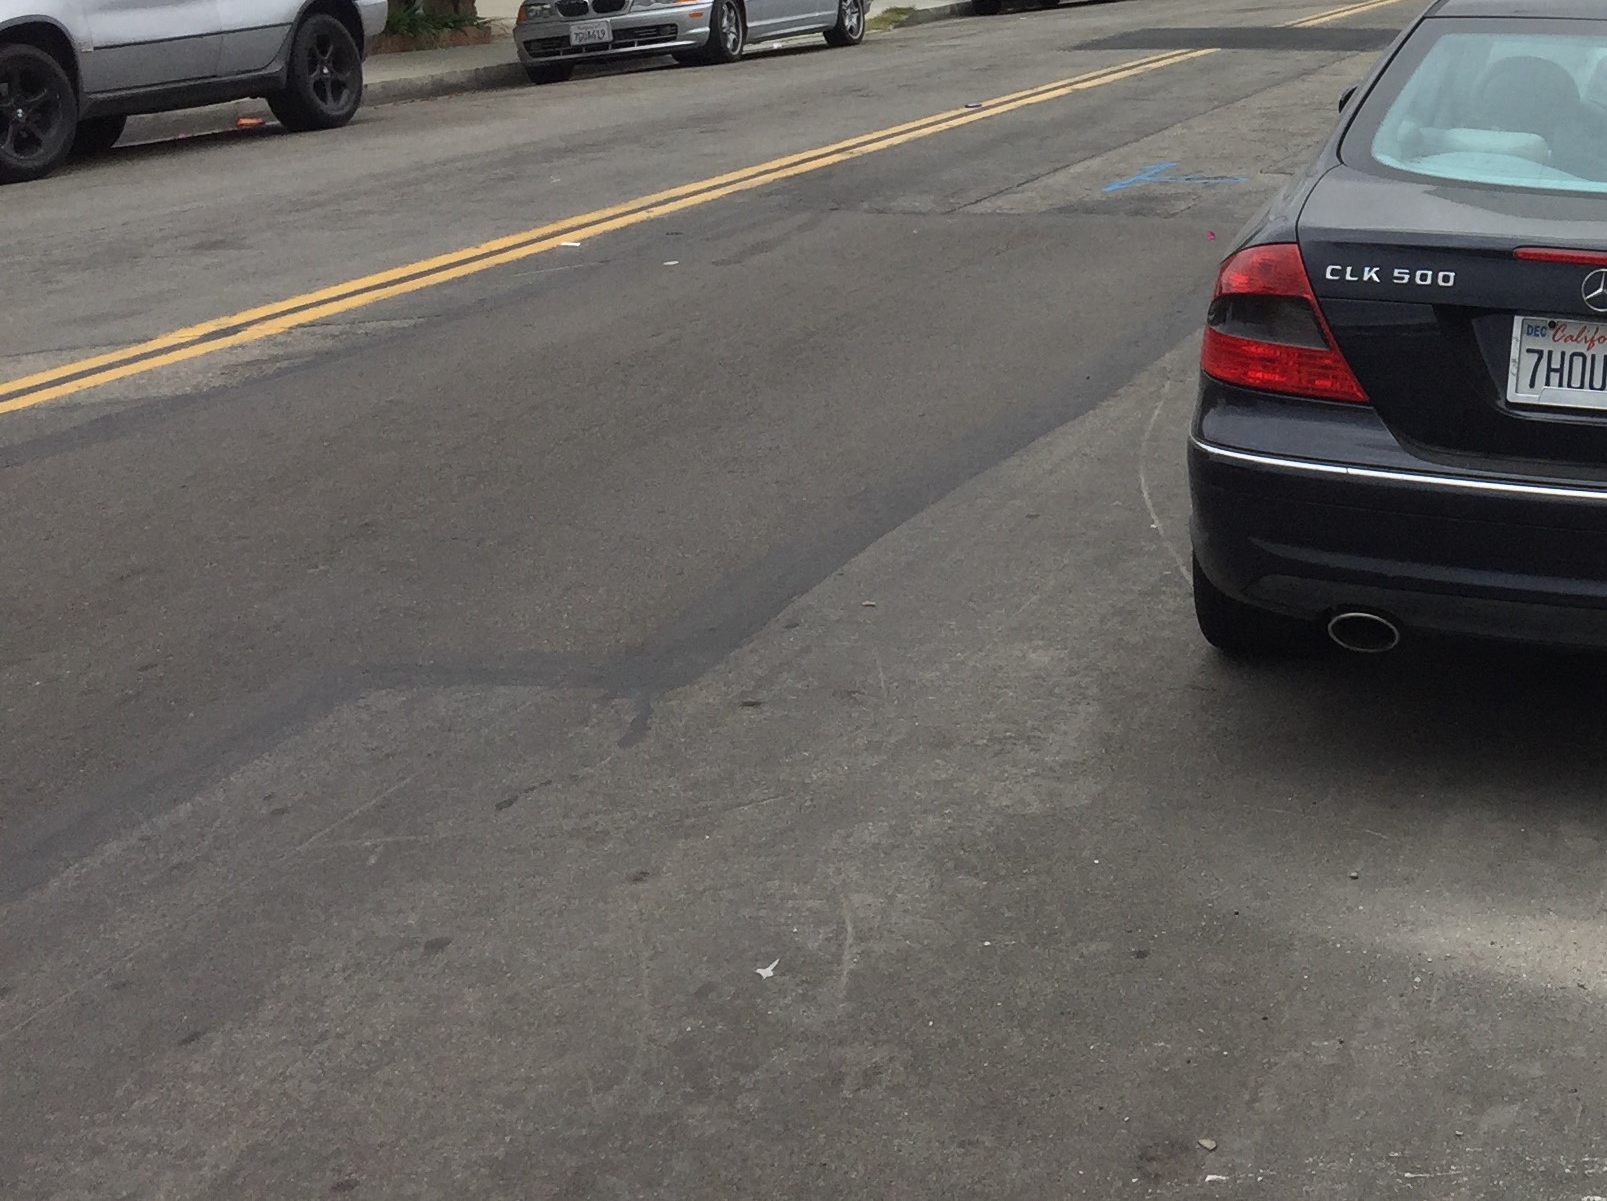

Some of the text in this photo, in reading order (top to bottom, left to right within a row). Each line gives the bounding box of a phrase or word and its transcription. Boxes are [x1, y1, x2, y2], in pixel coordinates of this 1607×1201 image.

[1325, 265, 1456, 287] CLK 500
[1526, 325, 1547, 338] DEC
